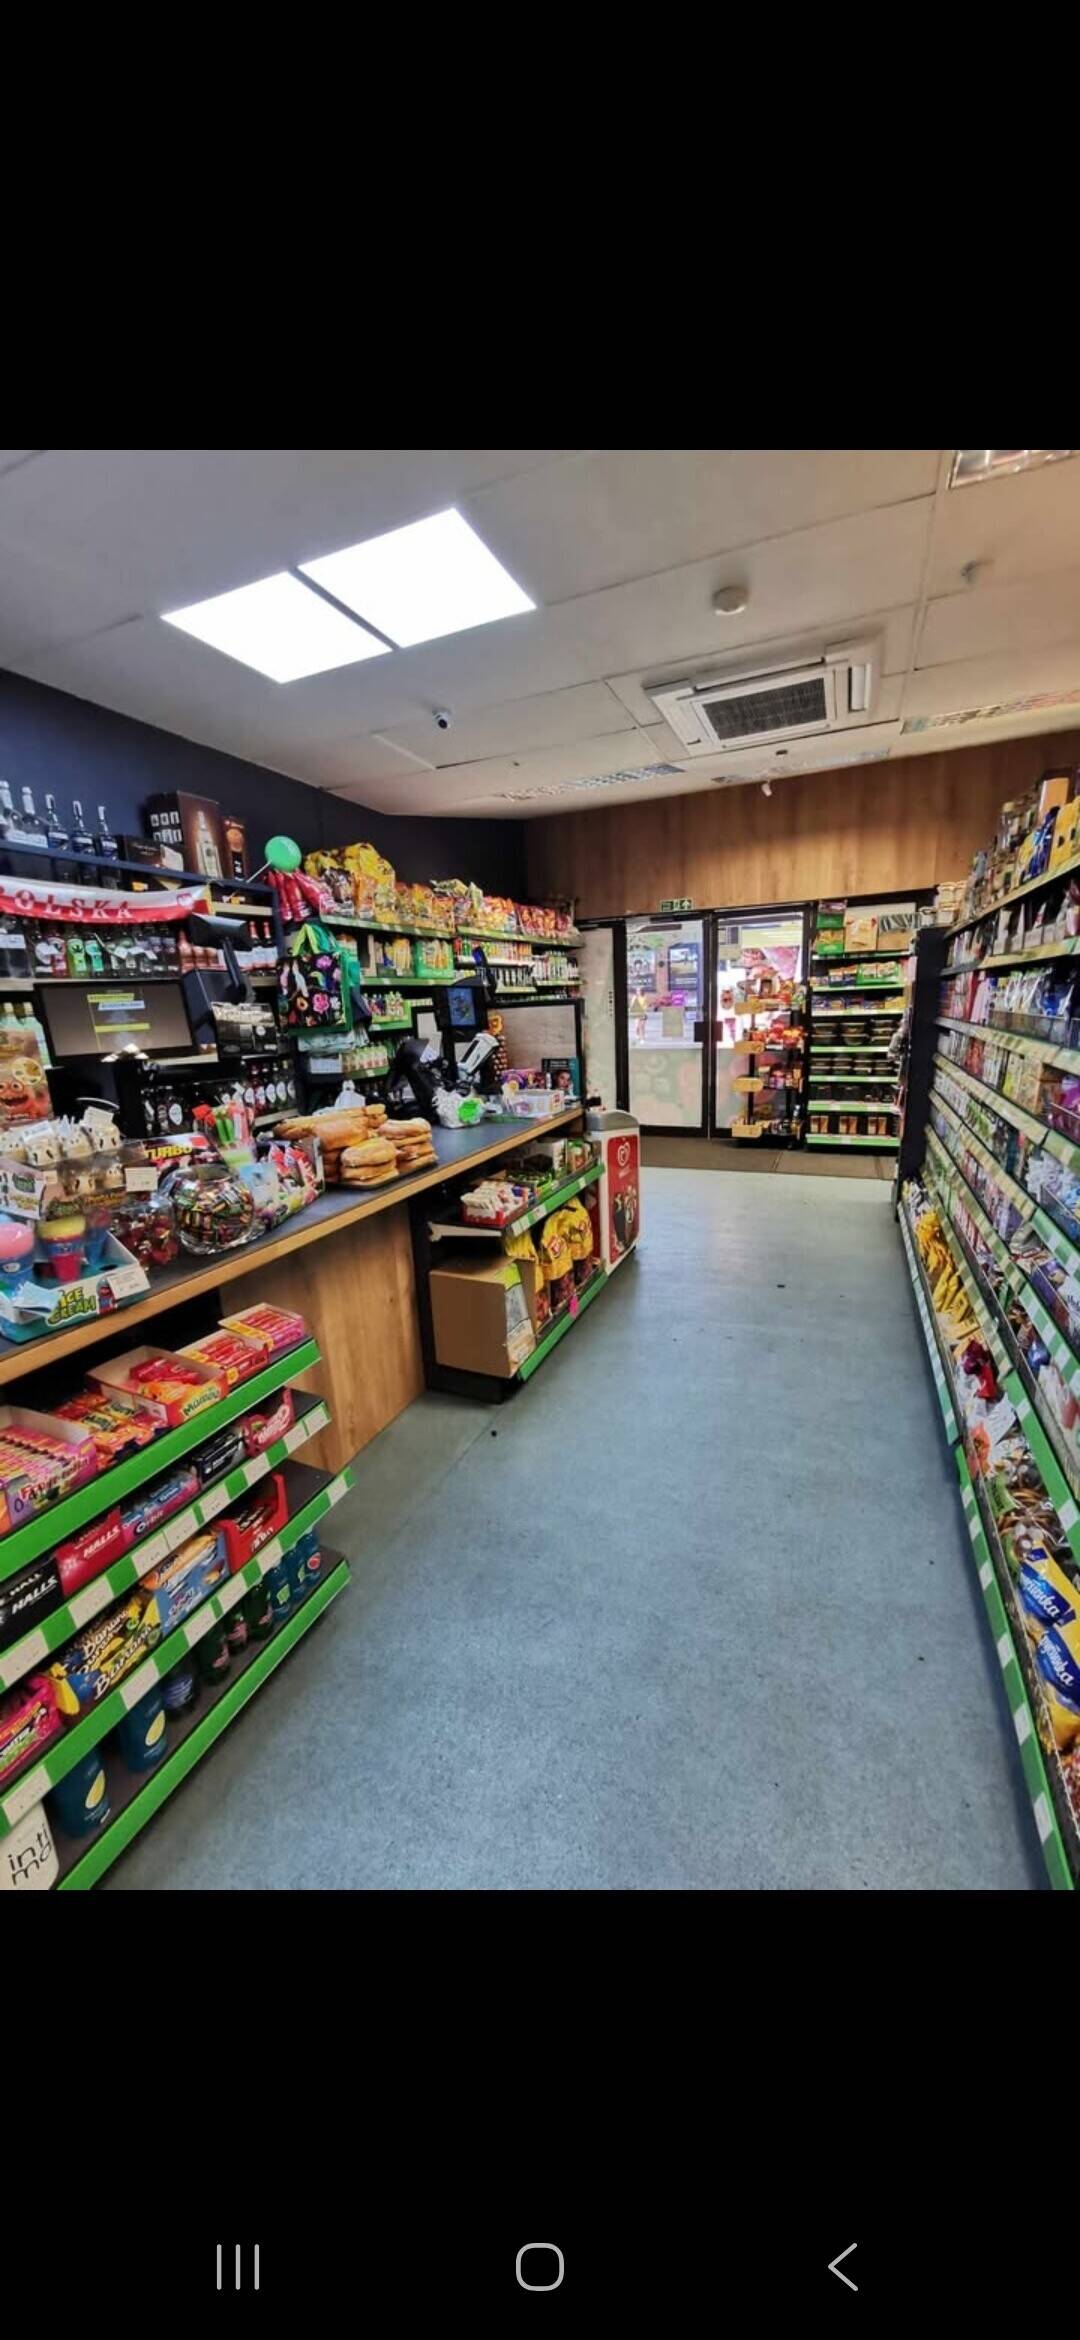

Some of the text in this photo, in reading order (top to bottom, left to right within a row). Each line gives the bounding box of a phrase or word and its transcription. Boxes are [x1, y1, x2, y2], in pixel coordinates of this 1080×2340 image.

[0, 886, 133, 919] OLSKA
[59, 1287, 83, 1306] ICE
[83, 1524, 120, 1559] HALLS
[11, 1575, 58, 1615] HALLS
